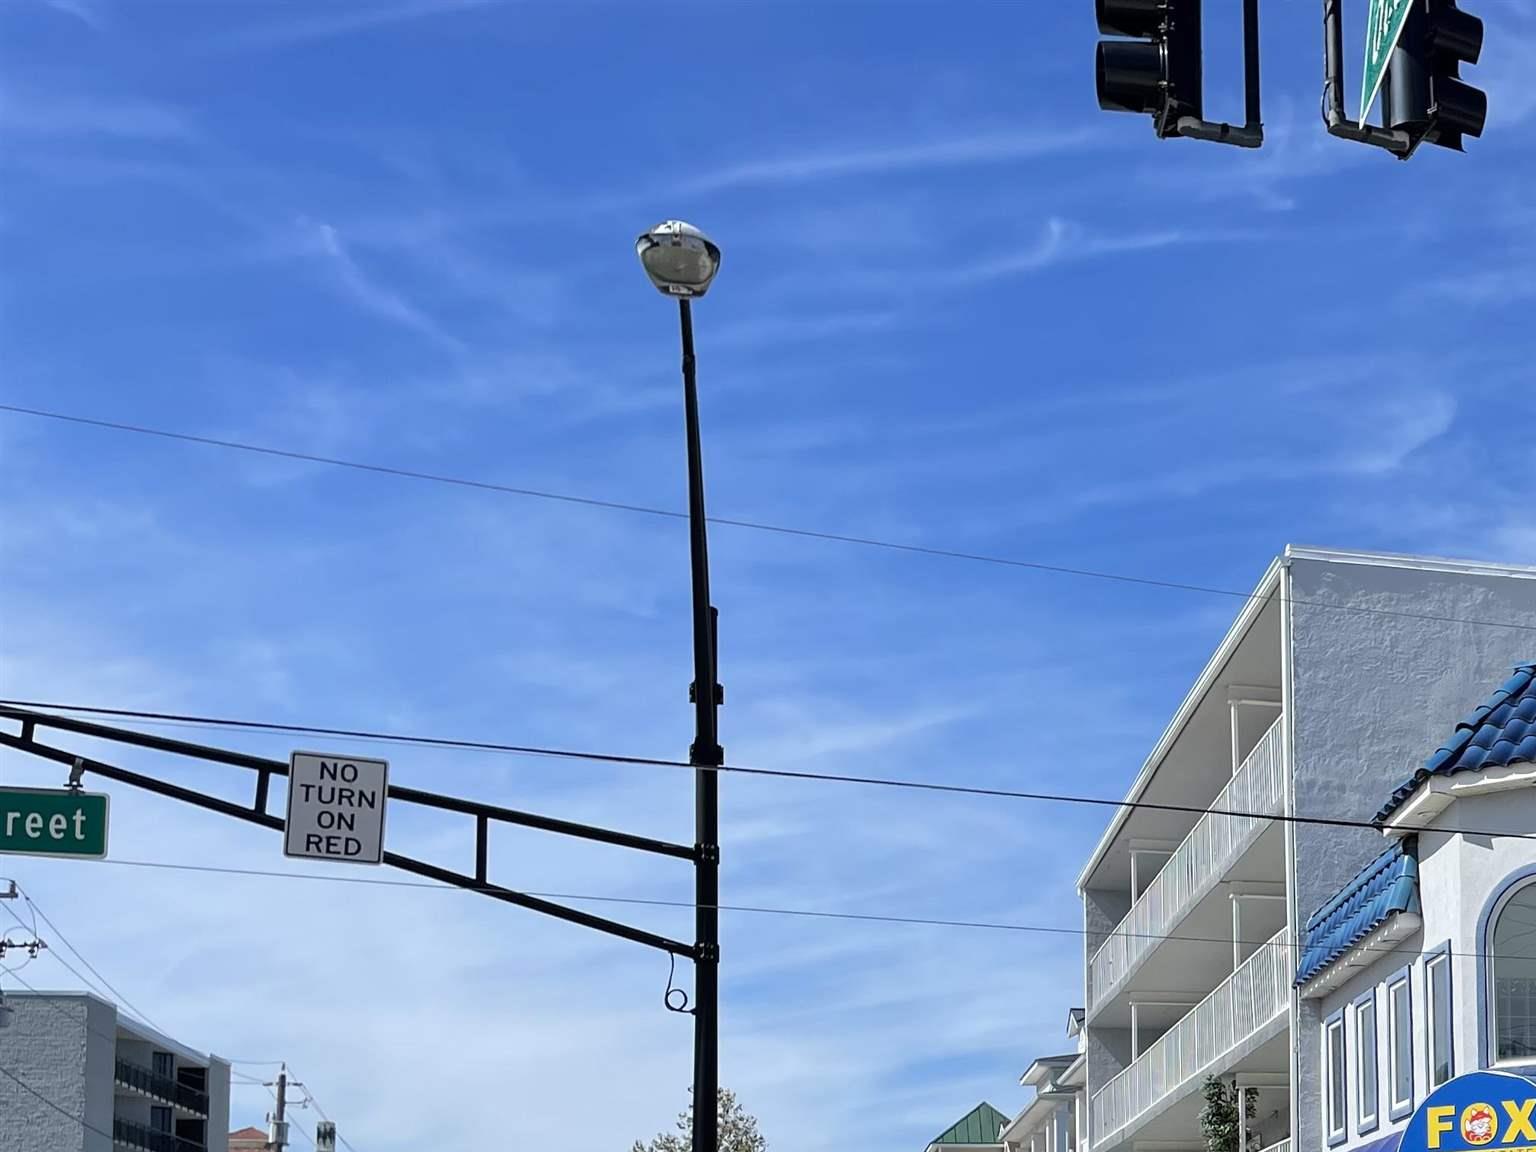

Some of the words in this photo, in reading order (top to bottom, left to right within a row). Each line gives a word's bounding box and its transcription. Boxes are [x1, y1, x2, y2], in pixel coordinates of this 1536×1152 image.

[320, 762, 358, 783] NO
[300, 784, 376, 809] TURN
[6, 808, 86, 840] reet
[317, 811, 355, 831] ON
[305, 833, 362, 856] RED
